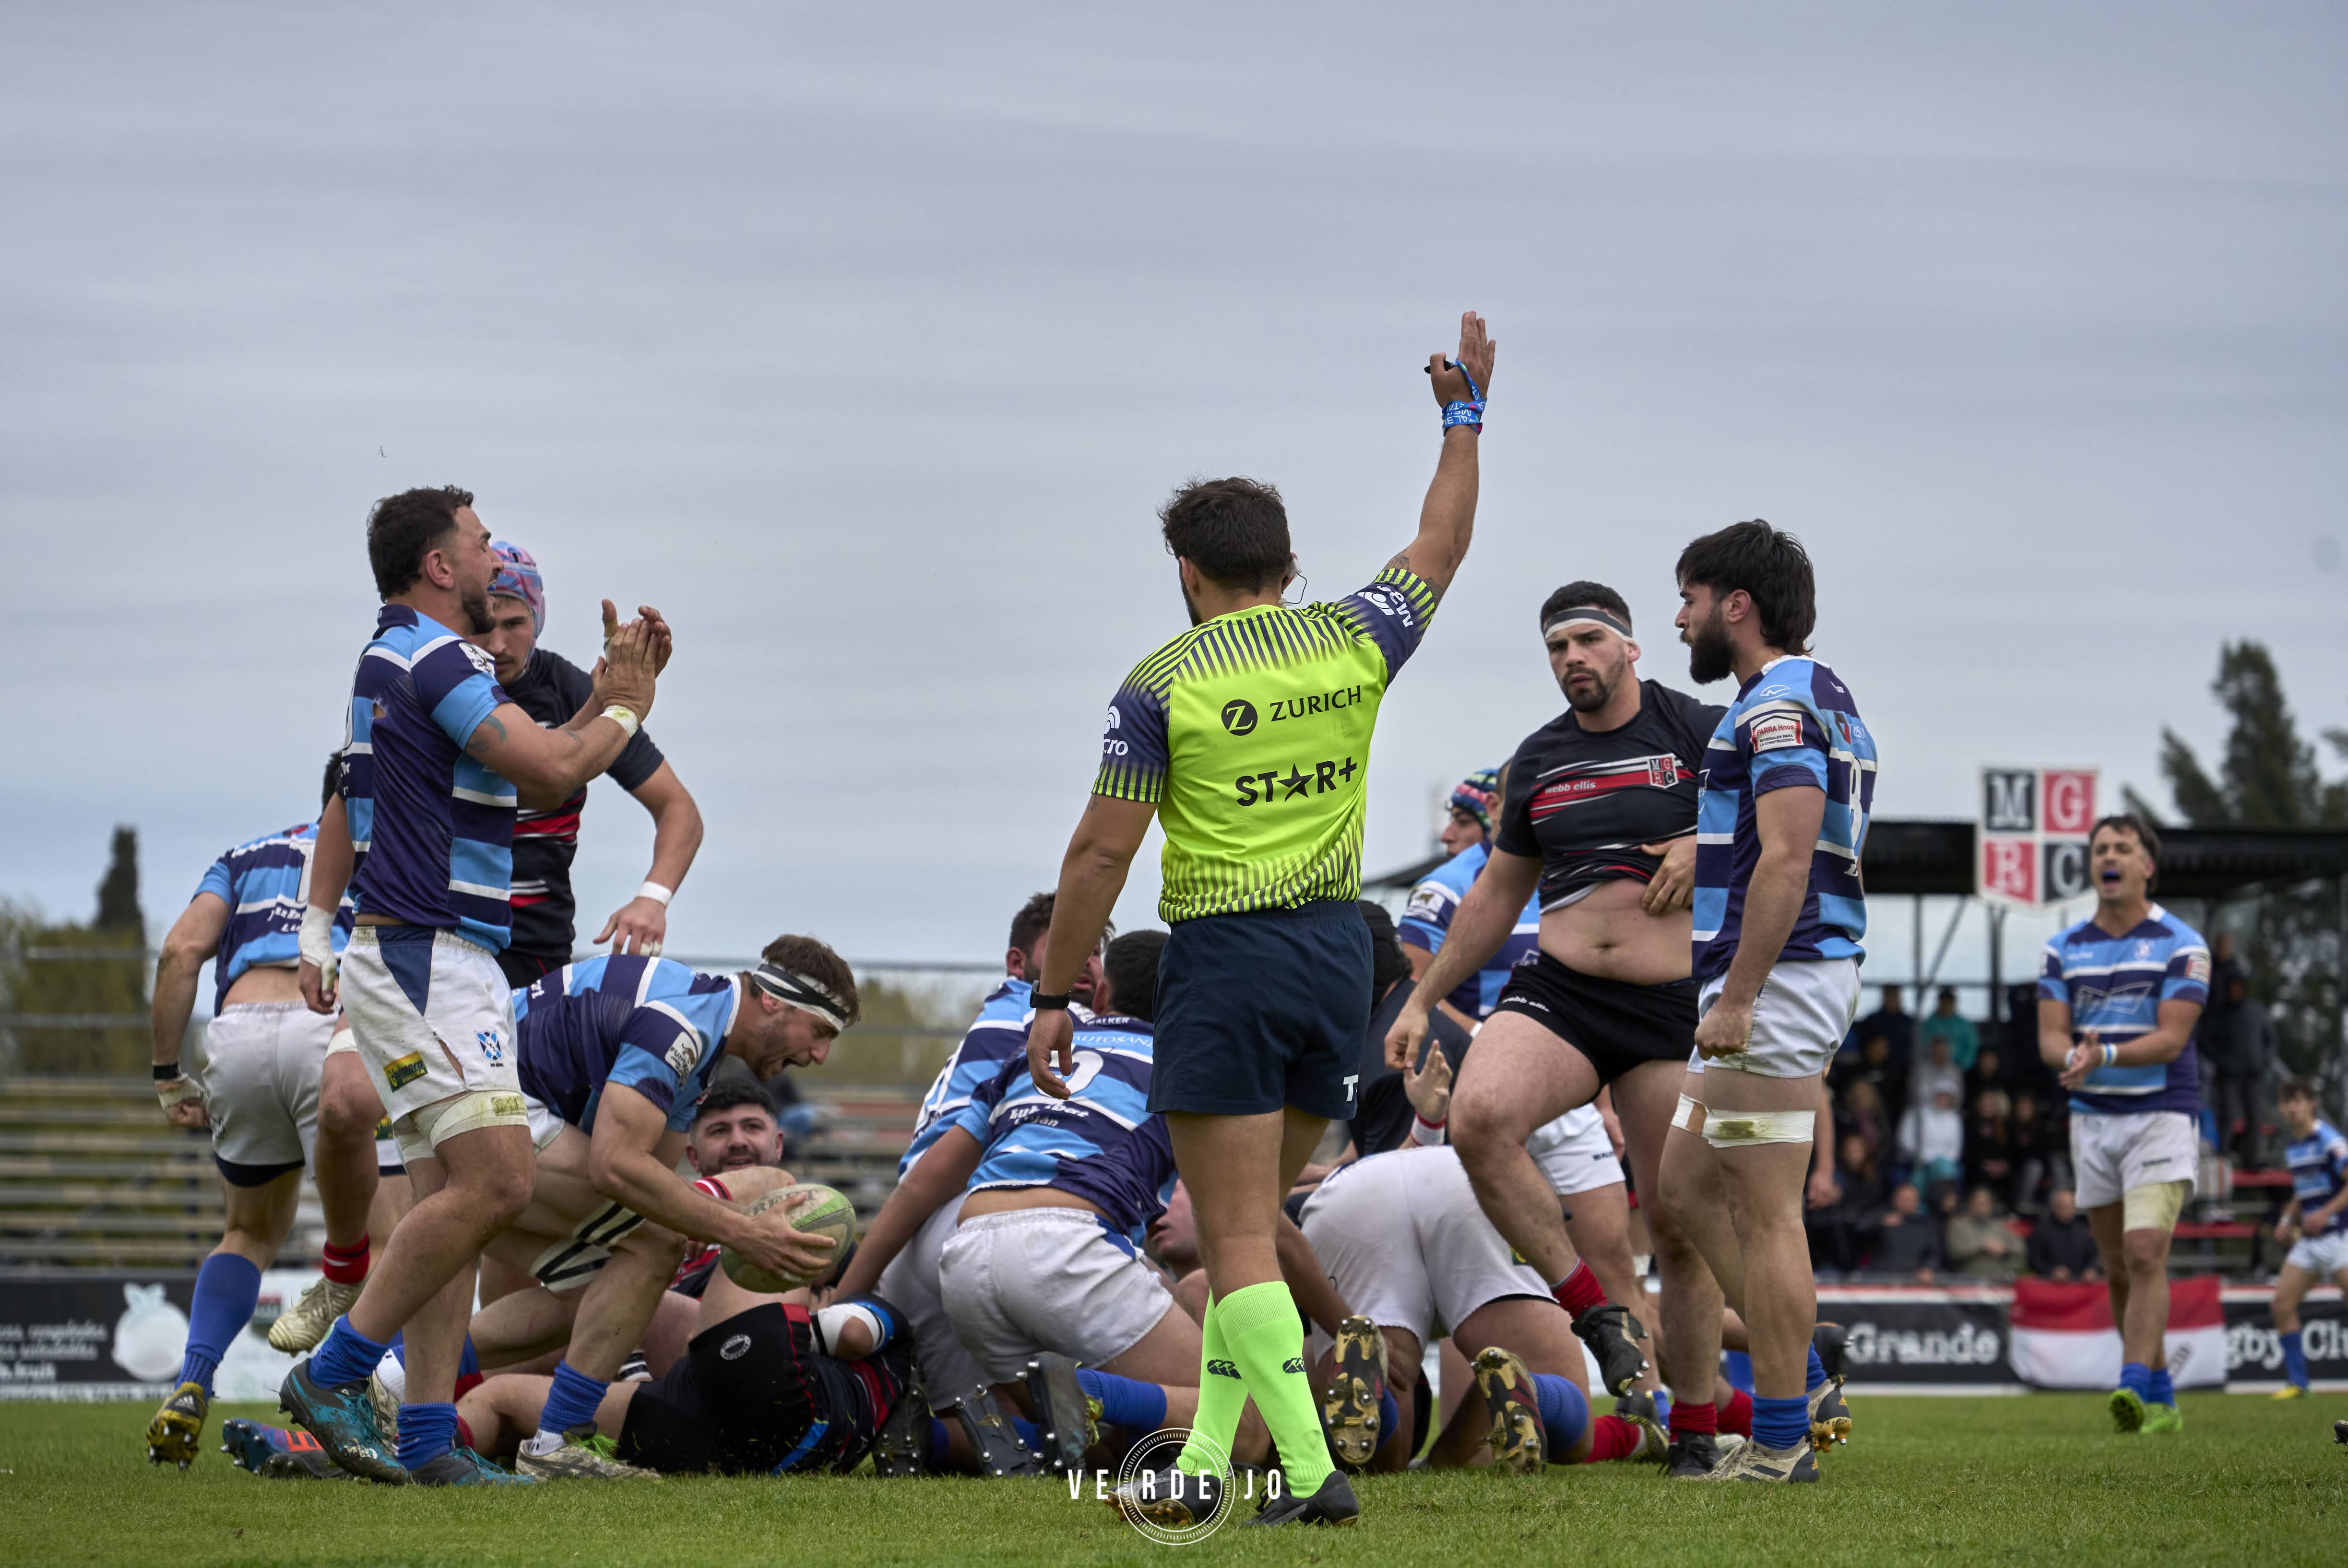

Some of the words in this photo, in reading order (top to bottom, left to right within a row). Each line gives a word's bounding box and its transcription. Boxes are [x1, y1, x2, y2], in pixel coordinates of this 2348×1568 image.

[1269, 684, 1362, 722] ZURICH
[1756, 725, 1778, 735] PARRA
[1545, 783, 1571, 794] webb
[1573, 780, 1596, 790] ellis
[1991, 775, 2029, 828] M
[2050, 773, 2086, 829] G
[2051, 845, 2084, 898] C
[1087, 1017, 1130, 1026] WALKER
[1845, 1322, 1999, 1364] Grande
[2302, 1319, 2348, 1361] Cl
